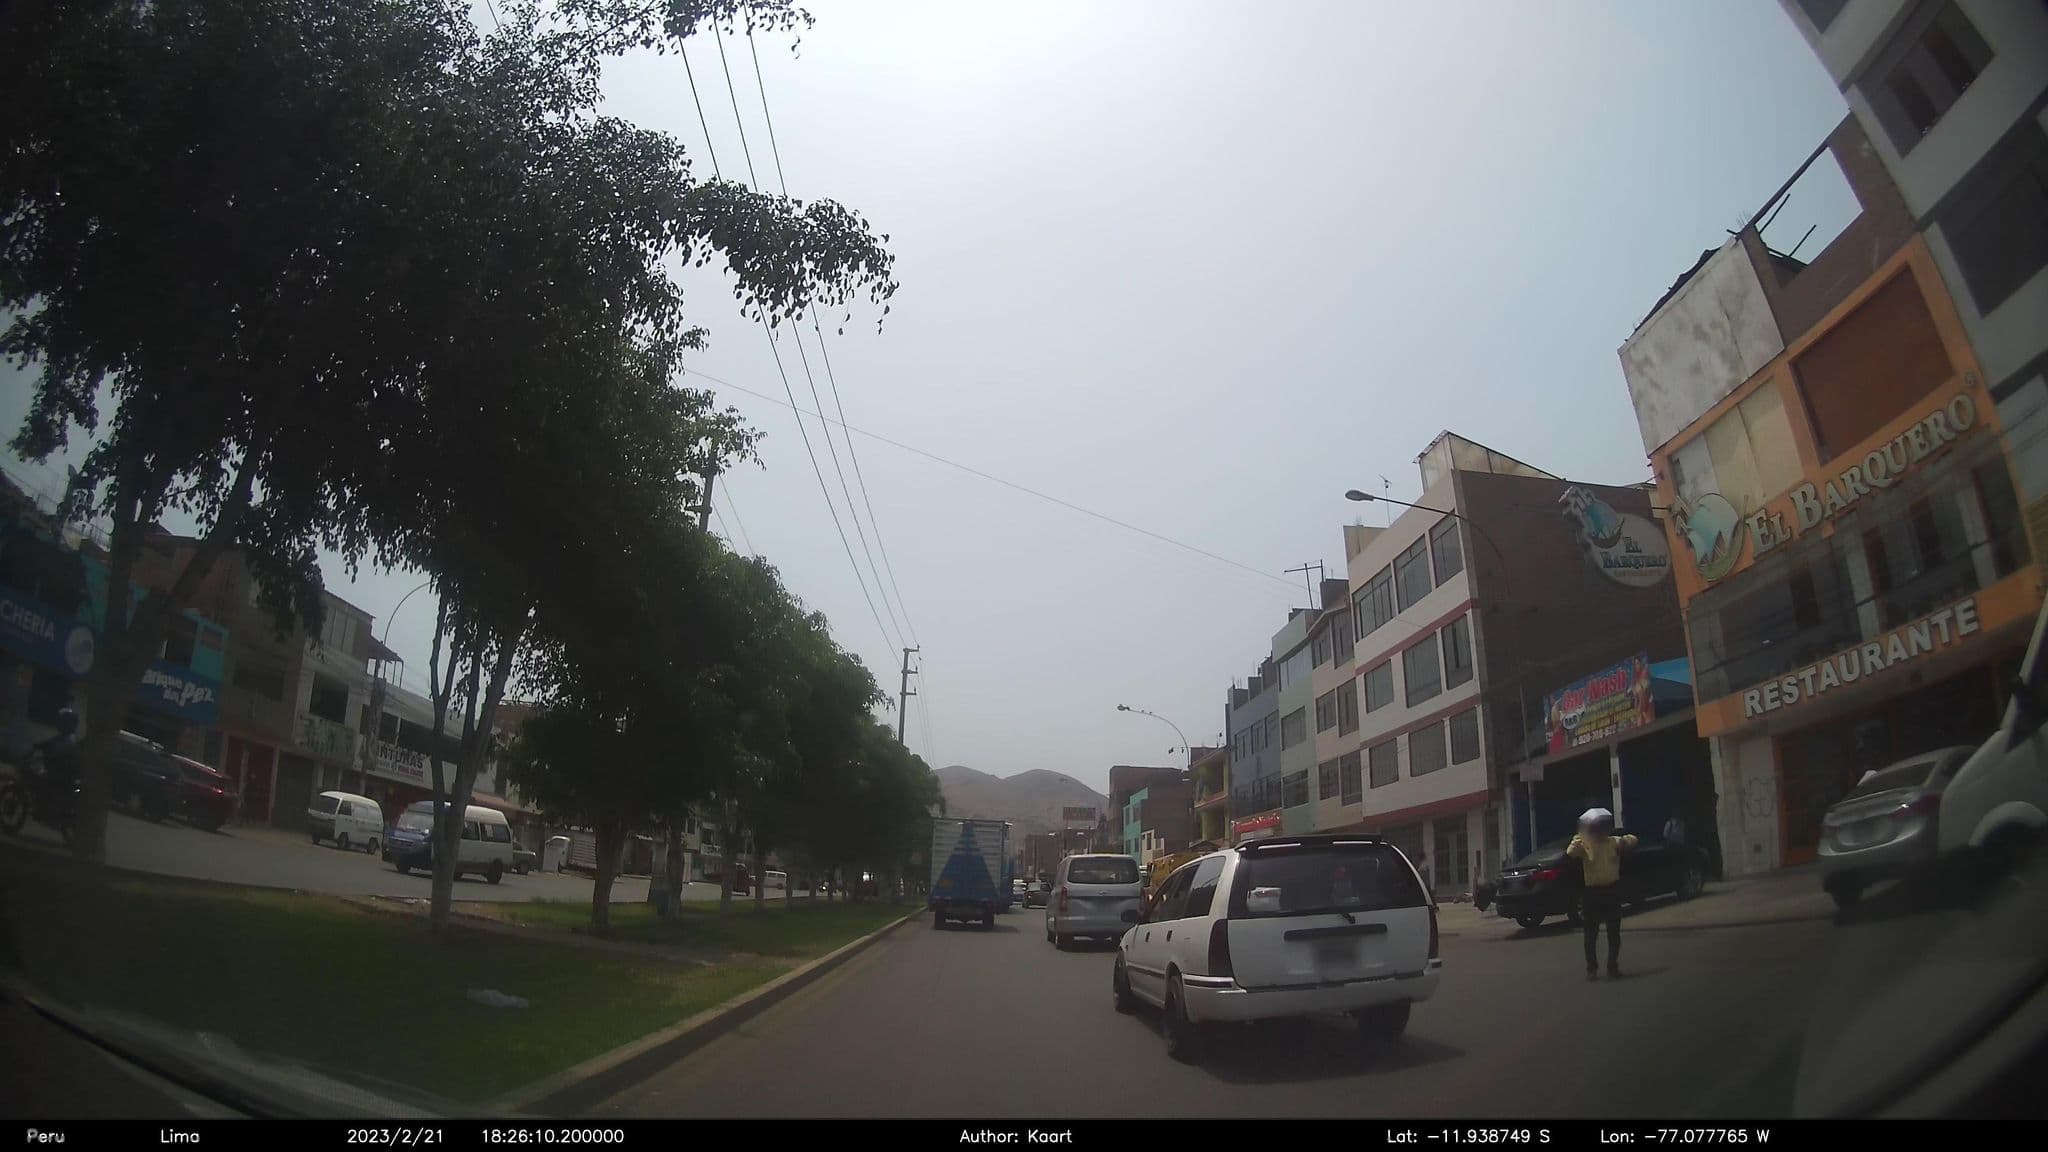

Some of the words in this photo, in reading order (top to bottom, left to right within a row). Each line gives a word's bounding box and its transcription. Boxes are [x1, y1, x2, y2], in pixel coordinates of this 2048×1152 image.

[1746, 509, 1791, 557] EL
[1790, 393, 1975, 531] BARQUERO
[1743, 597, 1979, 718] RESTAURANTE
